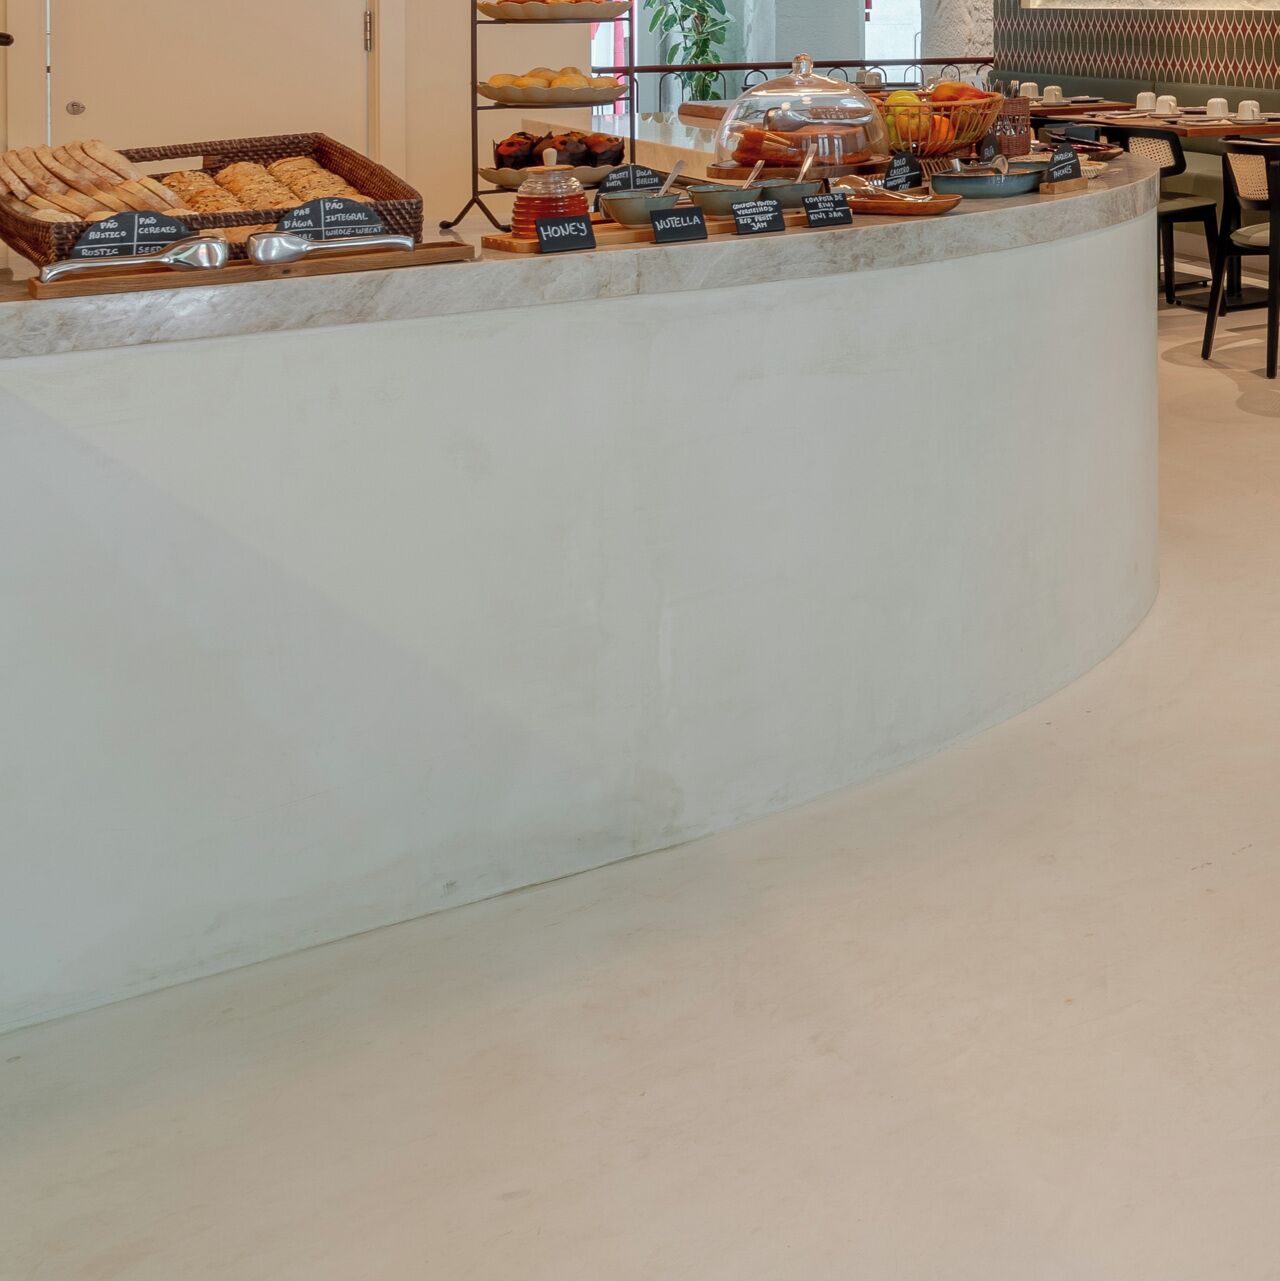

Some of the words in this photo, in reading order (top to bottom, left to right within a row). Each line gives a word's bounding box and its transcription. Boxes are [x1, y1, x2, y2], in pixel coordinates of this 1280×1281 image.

[834, 193, 844, 201] DE
[325, 199, 344, 211] PÃO
[325, 212, 369, 222] INTEGRAL
[809, 212, 826, 220] KIWI
[100, 219, 119, 230] PÃO
[655, 215, 701, 232] NUTELLA
[750, 221, 768, 231] JAM
[138, 226, 177, 235] CEREAIS
[540, 221, 588, 241] HONEY
[81, 248, 119, 256] RUSTIC
